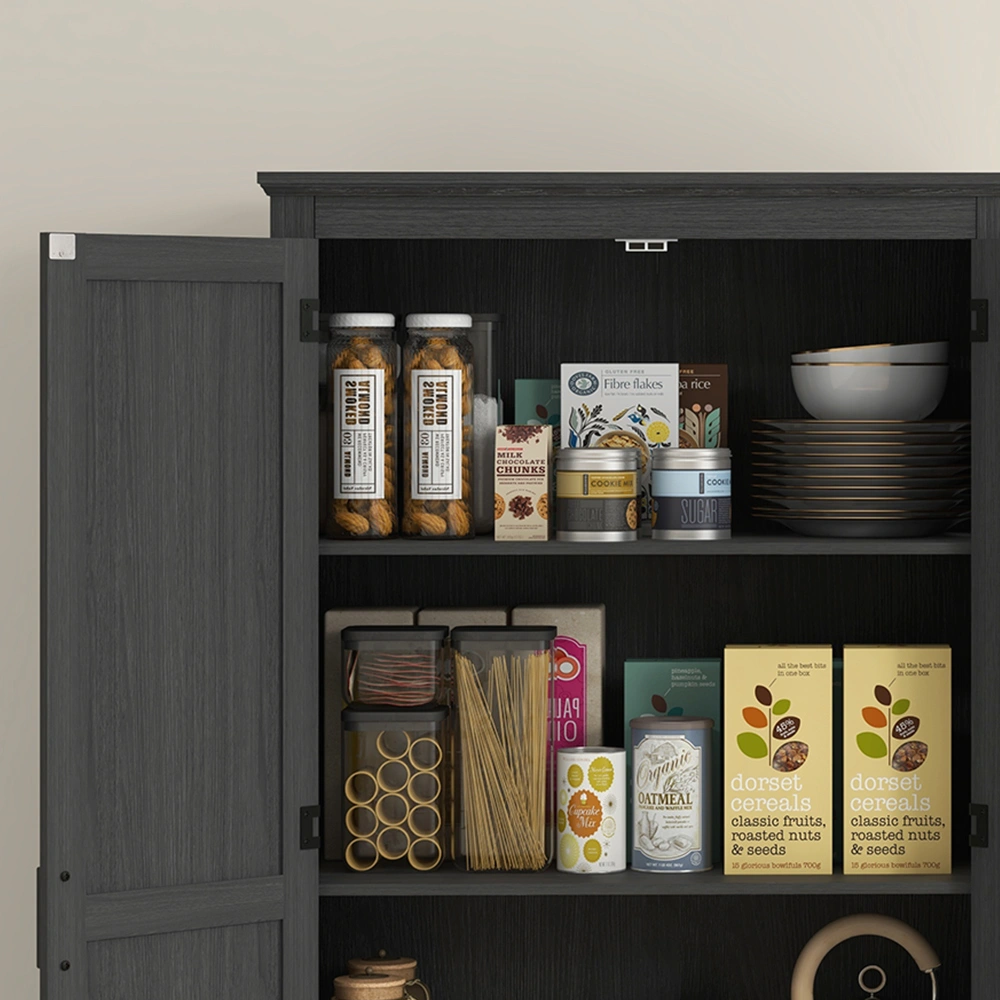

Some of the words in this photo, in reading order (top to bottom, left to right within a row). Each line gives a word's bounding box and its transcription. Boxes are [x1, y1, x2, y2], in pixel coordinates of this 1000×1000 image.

[604, 378, 630, 389] Fibre
[633, 378, 663, 389] flakes
[691, 378, 711, 389] rice
[681, 499, 718, 524] SUGAR
[636, 749, 692, 790] Organic
[731, 774, 803, 792] dorset
[850, 773, 922, 791] dorset
[638, 793, 693, 805] OATMEAL
[731, 794, 812, 812] cereals
[850, 794, 931, 812] cereals
[568, 804, 600, 818] Cupcake
[580, 817, 596, 828] Mix
[731, 815, 779, 827] classic
[783, 815, 826, 828] fruits,
[851, 815, 899, 827] classic
[902, 815, 946, 828] fruits,
[732, 830, 785, 841] roasted
[788, 830, 821, 841] nuts
[851, 830, 904, 841] roasted
[908, 830, 940, 841] nuts
[732, 844, 743, 855] &
[747, 844, 786, 856] seeds
[851, 844, 863, 855] &
[866, 844, 906, 855] seeds
